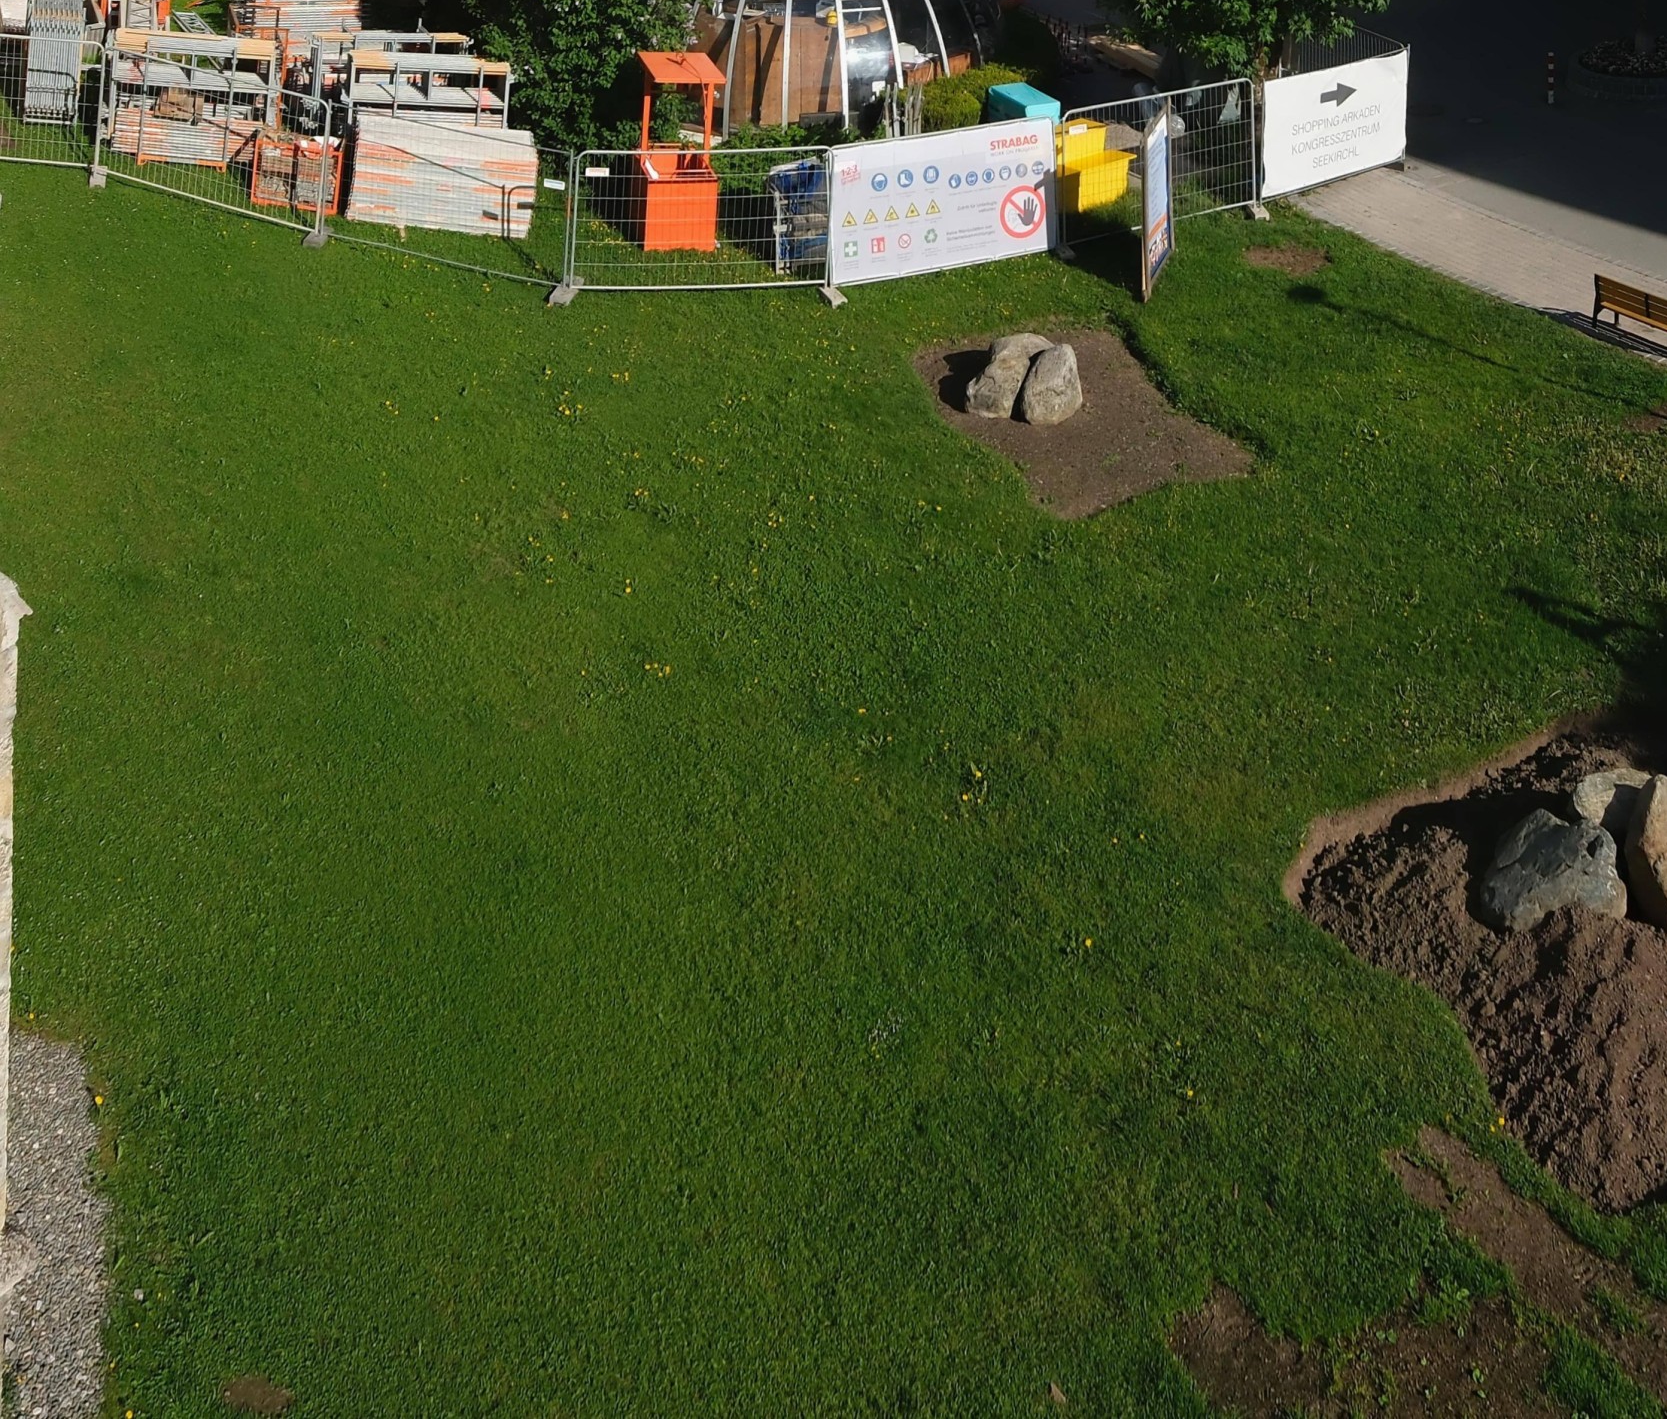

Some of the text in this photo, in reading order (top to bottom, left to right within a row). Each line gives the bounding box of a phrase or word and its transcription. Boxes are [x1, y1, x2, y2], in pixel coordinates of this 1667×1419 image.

[1291, 104, 1381, 136] SHOPPING ARKADEN
[990, 134, 1039, 151] STRABAG
[1291, 121, 1381, 155] KONGRESSZENTRUM
[1312, 145, 1360, 169] SEEKIRCHL
